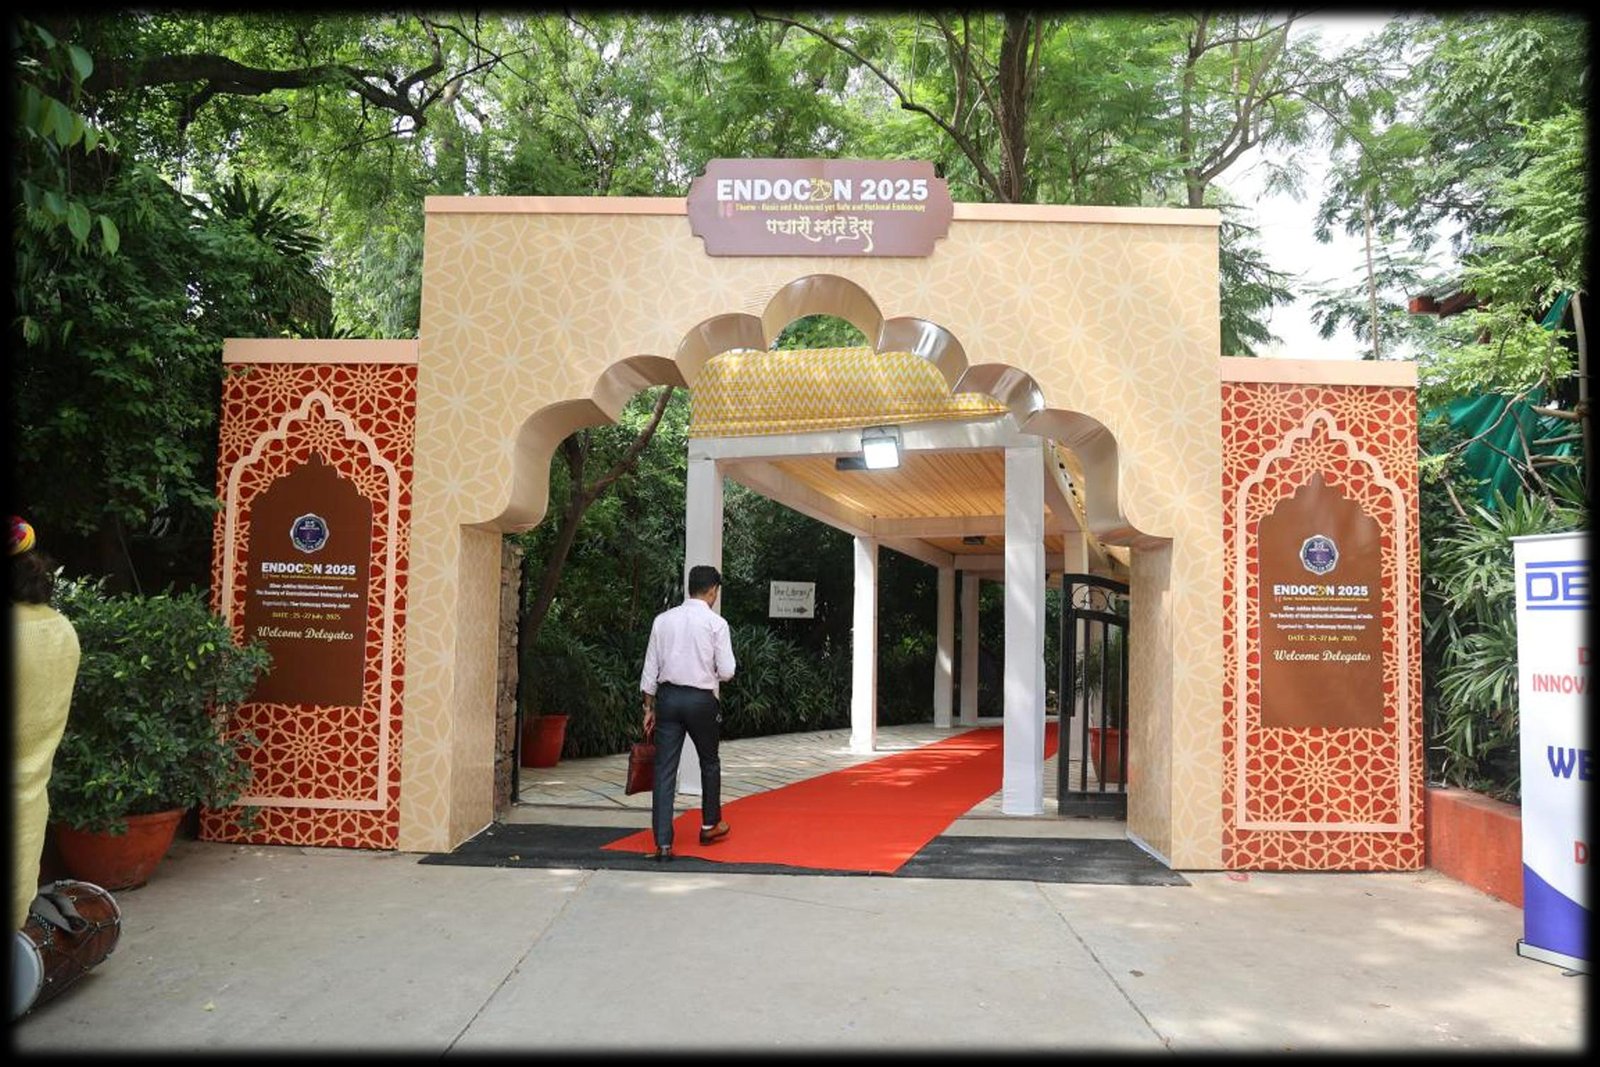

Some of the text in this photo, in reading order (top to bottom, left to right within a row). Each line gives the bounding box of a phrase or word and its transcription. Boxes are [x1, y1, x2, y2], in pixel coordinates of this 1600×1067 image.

[860, 178, 929, 201] 2025
[324, 564, 356, 575] 2025
[1338, 585, 1369, 596] 2025
[257, 626, 354, 642] Welcome Delegates
[1273, 649, 1371, 664] Welcome Delegates
[1532, 673, 1593, 695] INNOV
